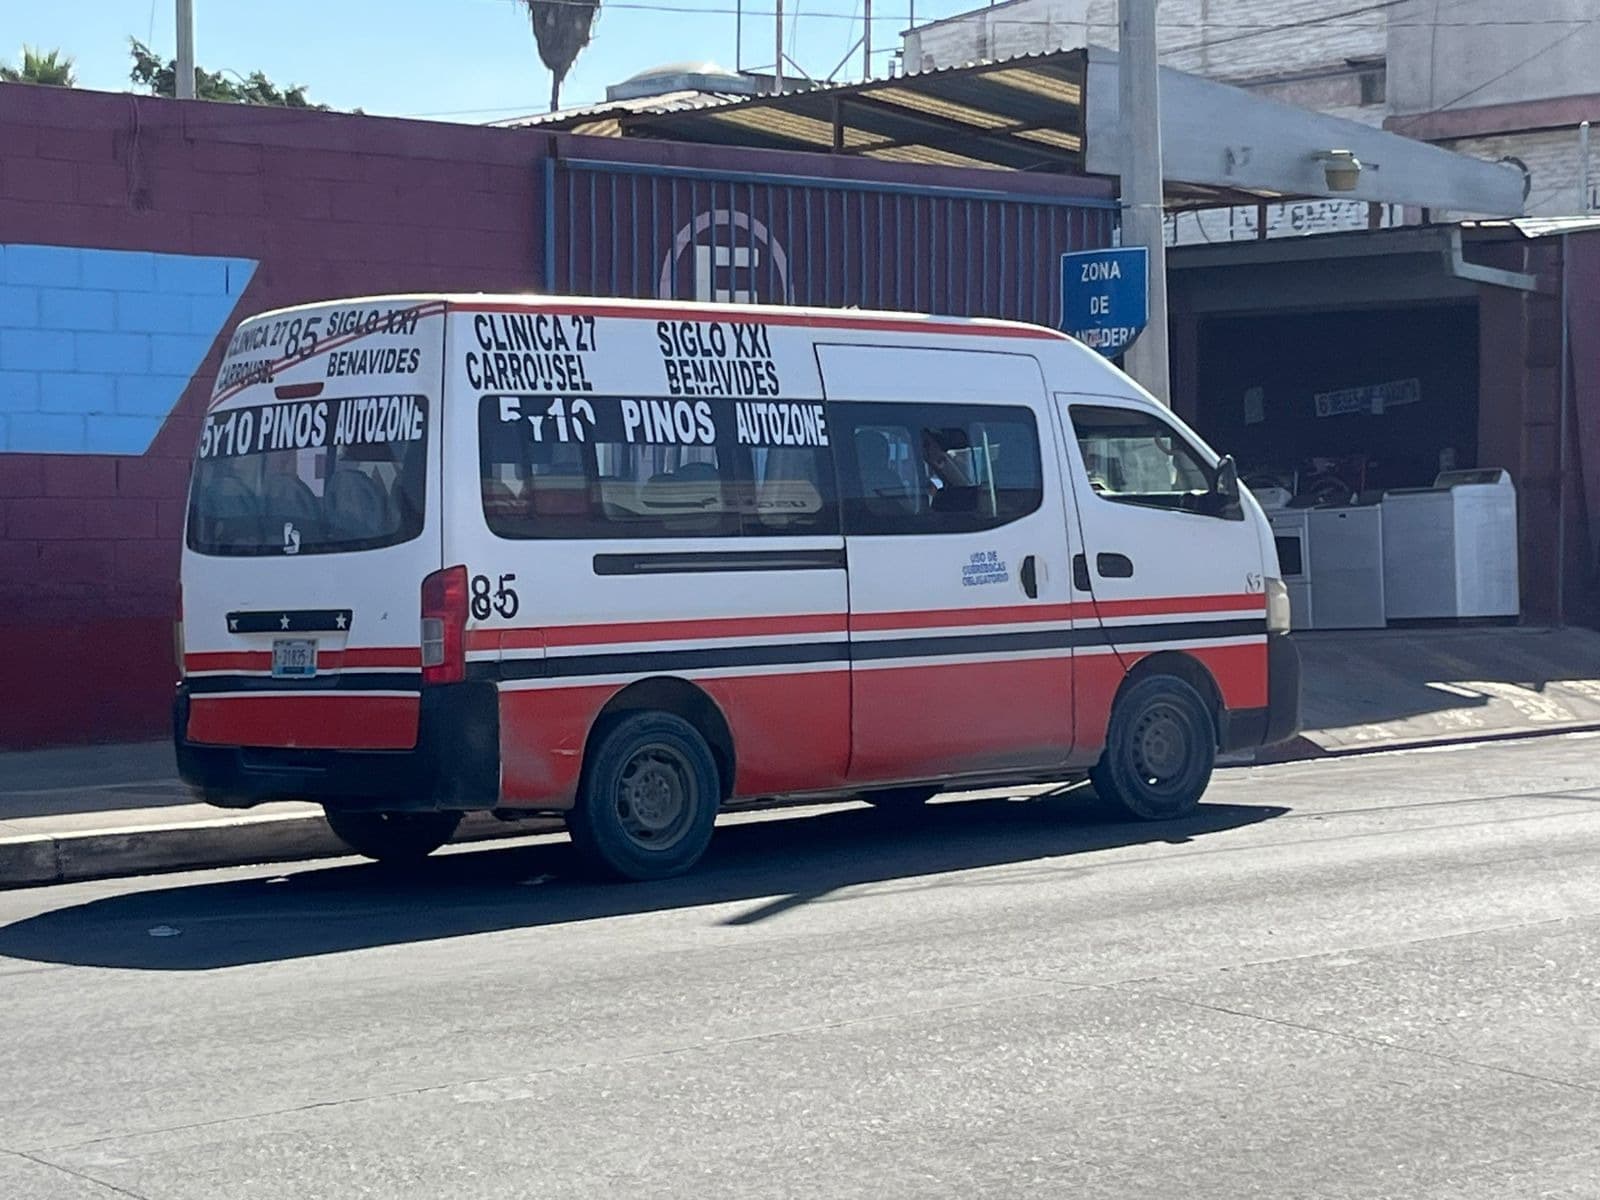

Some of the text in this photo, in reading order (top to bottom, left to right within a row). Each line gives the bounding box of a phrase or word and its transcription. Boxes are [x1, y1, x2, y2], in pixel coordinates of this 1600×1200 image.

[1081, 261, 1121, 282] ZONA
[327, 309, 420, 336] SIGLO XXI
[1090, 296, 1110, 315] DE
[270, 321, 290, 346] 27
[285, 318, 322, 358] 85
[474, 315, 597, 351] CLINICA 27
[657, 321, 772, 359] SIGLO XXI
[327, 348, 420, 377] BENAVIDES
[465, 351, 593, 391] CARROUSEL
[665, 359, 780, 396] BENAVIDES
[257, 401, 328, 450] PINOS
[333, 396, 424, 445] AUTOZONE
[620, 400, 716, 444] PINOS
[735, 402, 829, 446] AUTOZONE
[471, 573, 519, 620] 85
